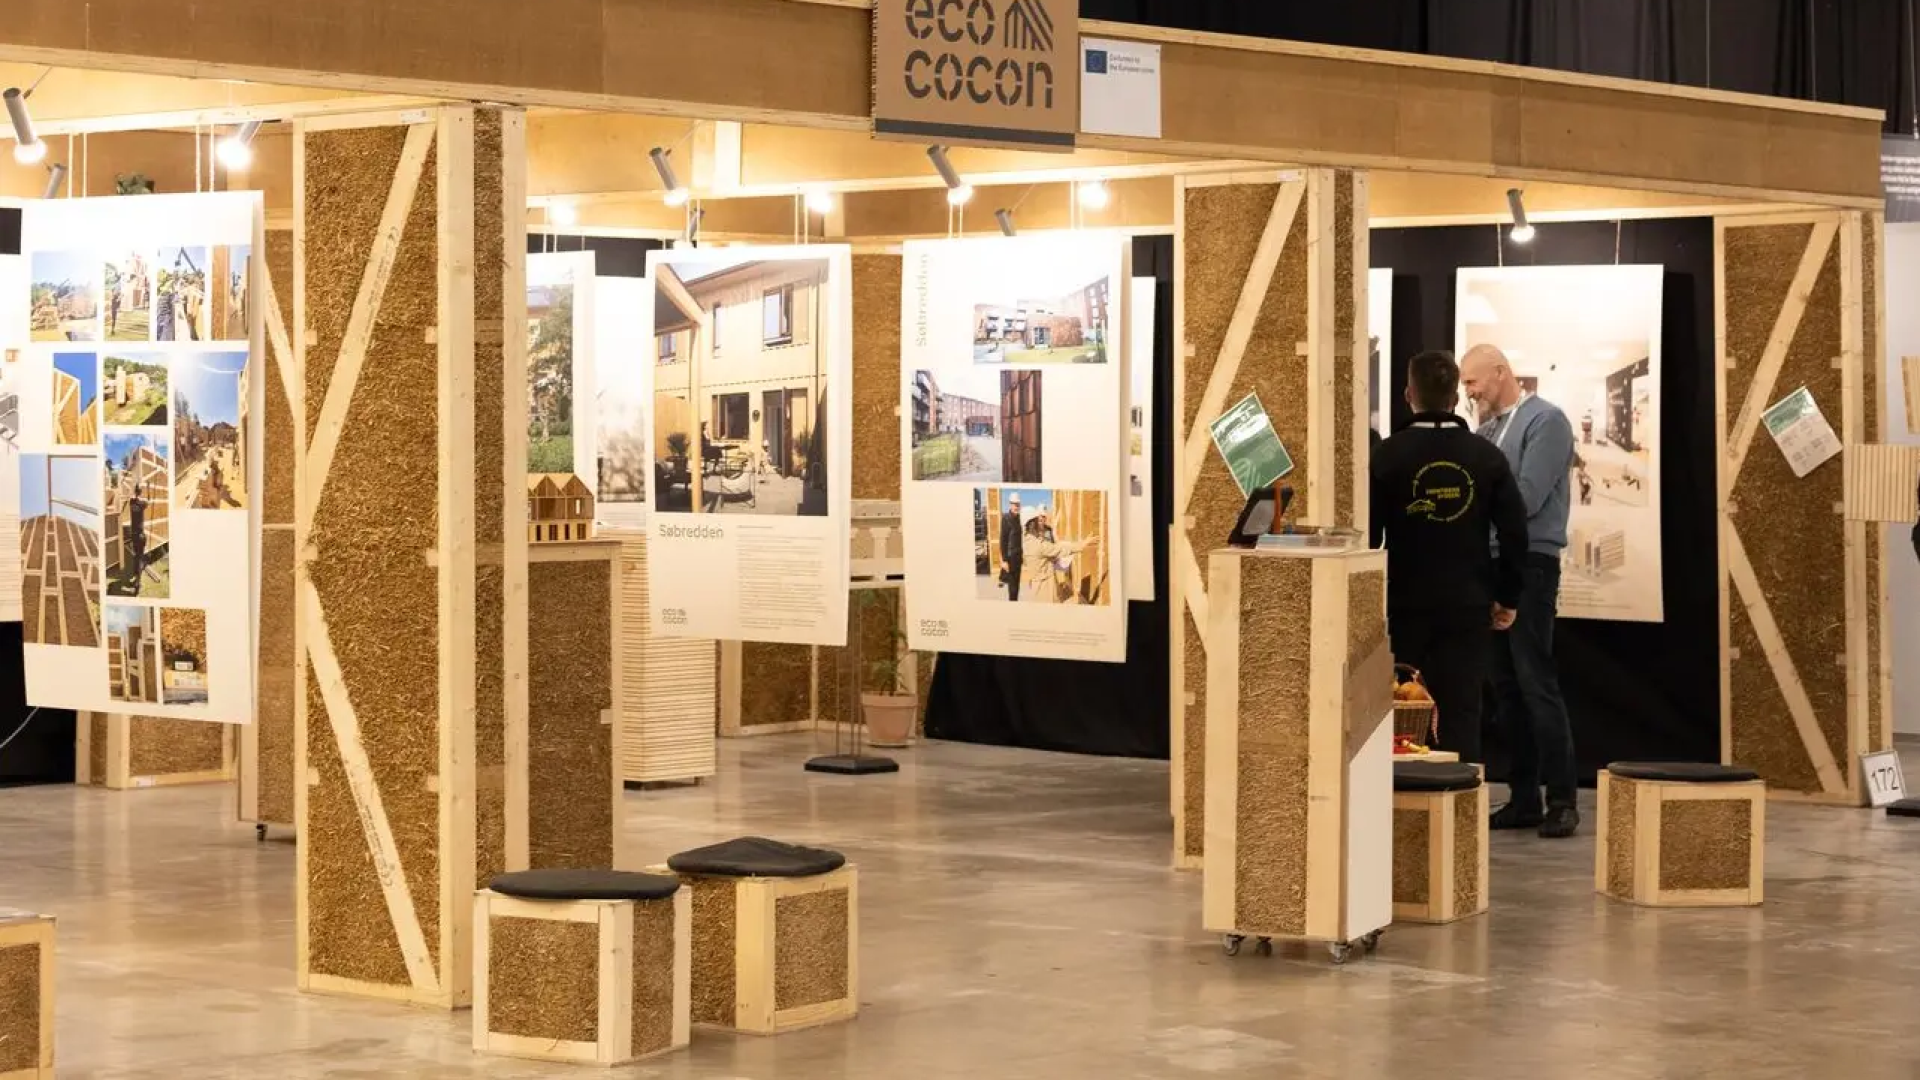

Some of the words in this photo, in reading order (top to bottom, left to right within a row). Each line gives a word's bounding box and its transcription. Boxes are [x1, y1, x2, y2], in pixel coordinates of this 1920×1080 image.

[905, 0, 995, 45] eco
[904, 49, 1054, 109] cocon
[659, 524, 724, 538] Søbredden
[1871, 766, 1900, 792] 172
